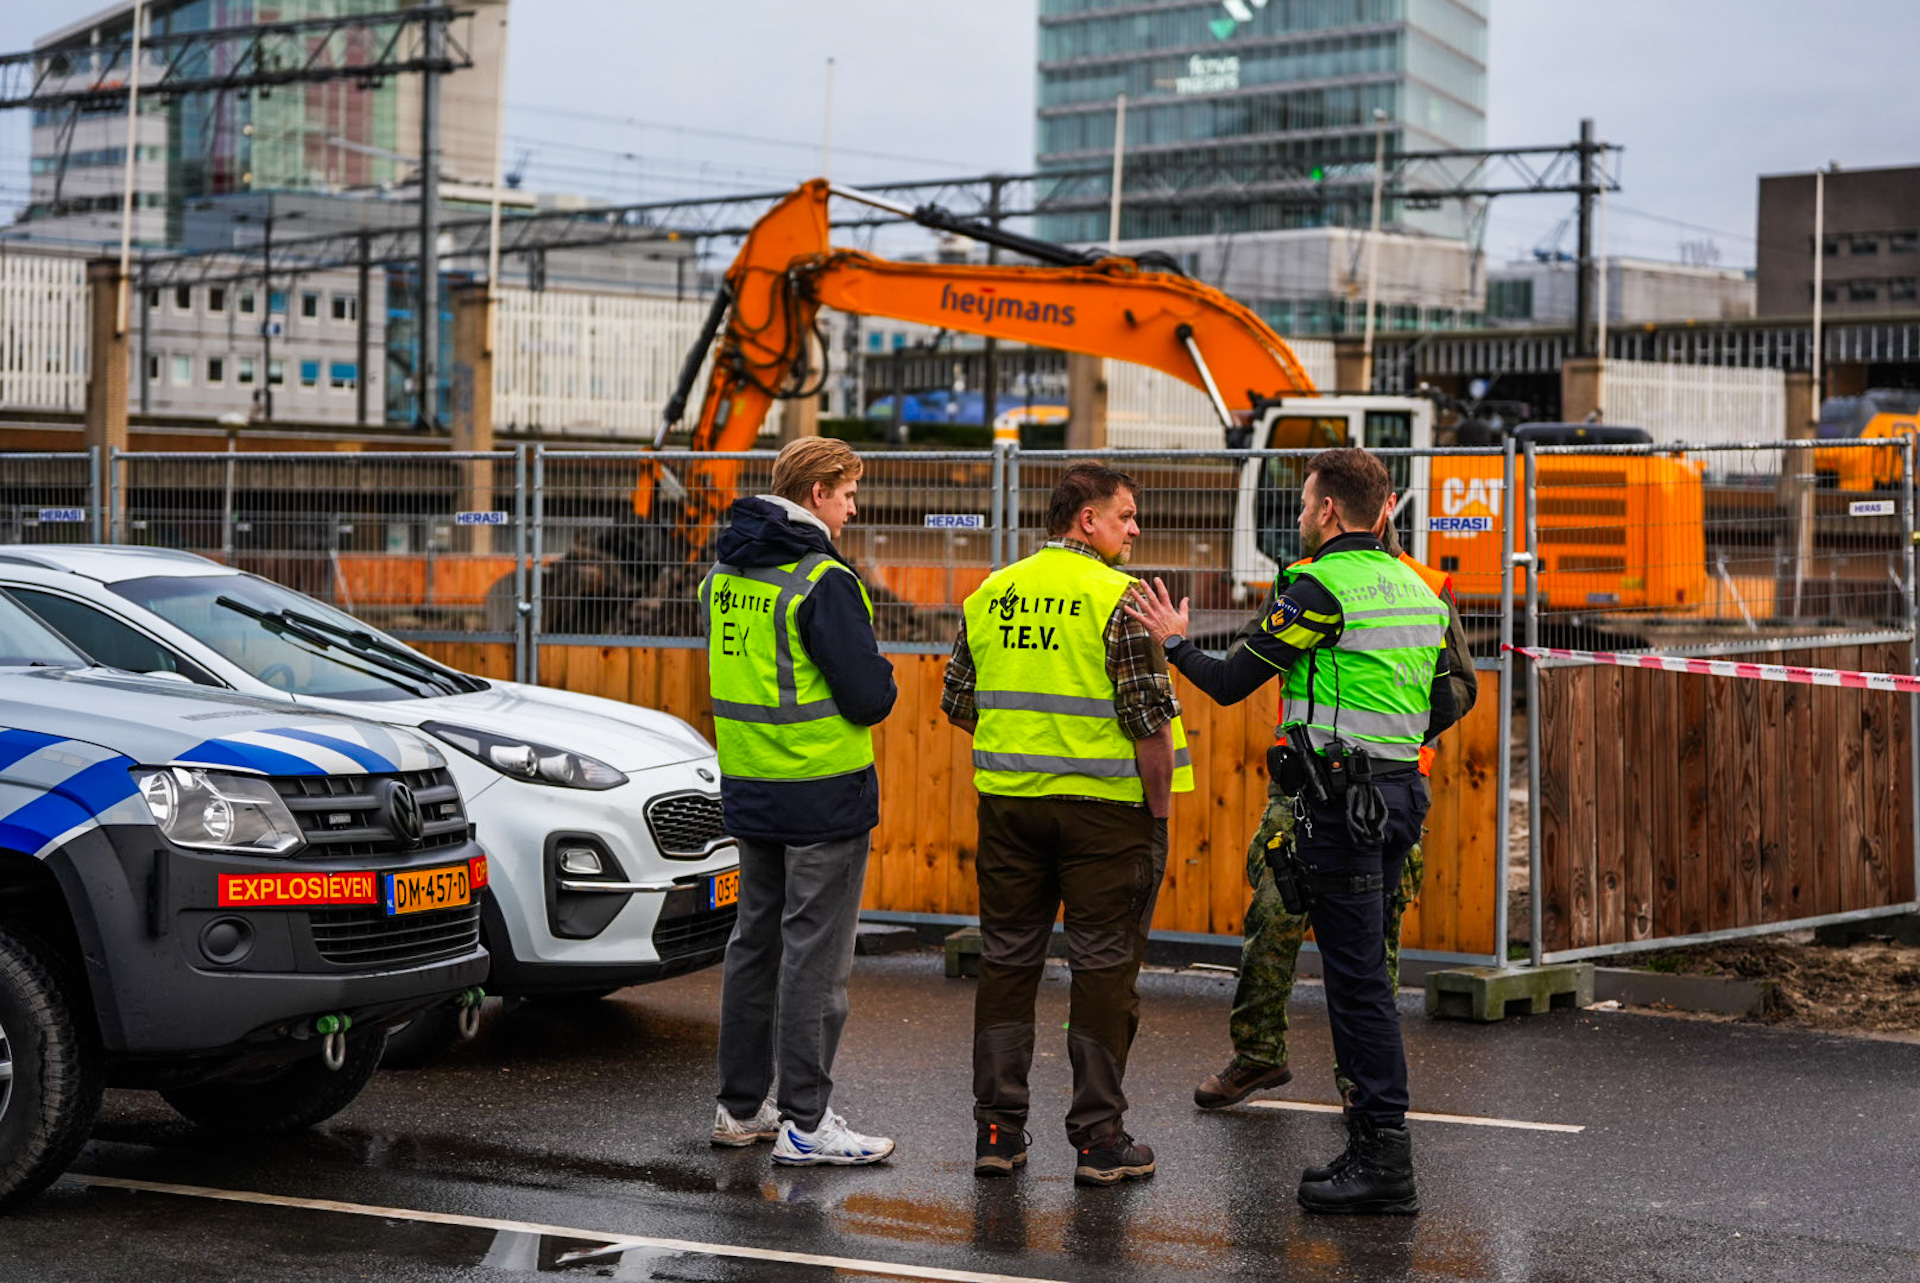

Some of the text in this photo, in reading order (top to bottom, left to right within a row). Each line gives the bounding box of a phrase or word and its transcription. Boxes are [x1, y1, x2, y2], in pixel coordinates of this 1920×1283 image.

[941, 283, 1076, 326] heijmans
[1442, 477, 1504, 516] CAT
[999, 625, 1059, 651] T.E.V.
[228, 877, 372, 900] EXPLOSIEVEN
